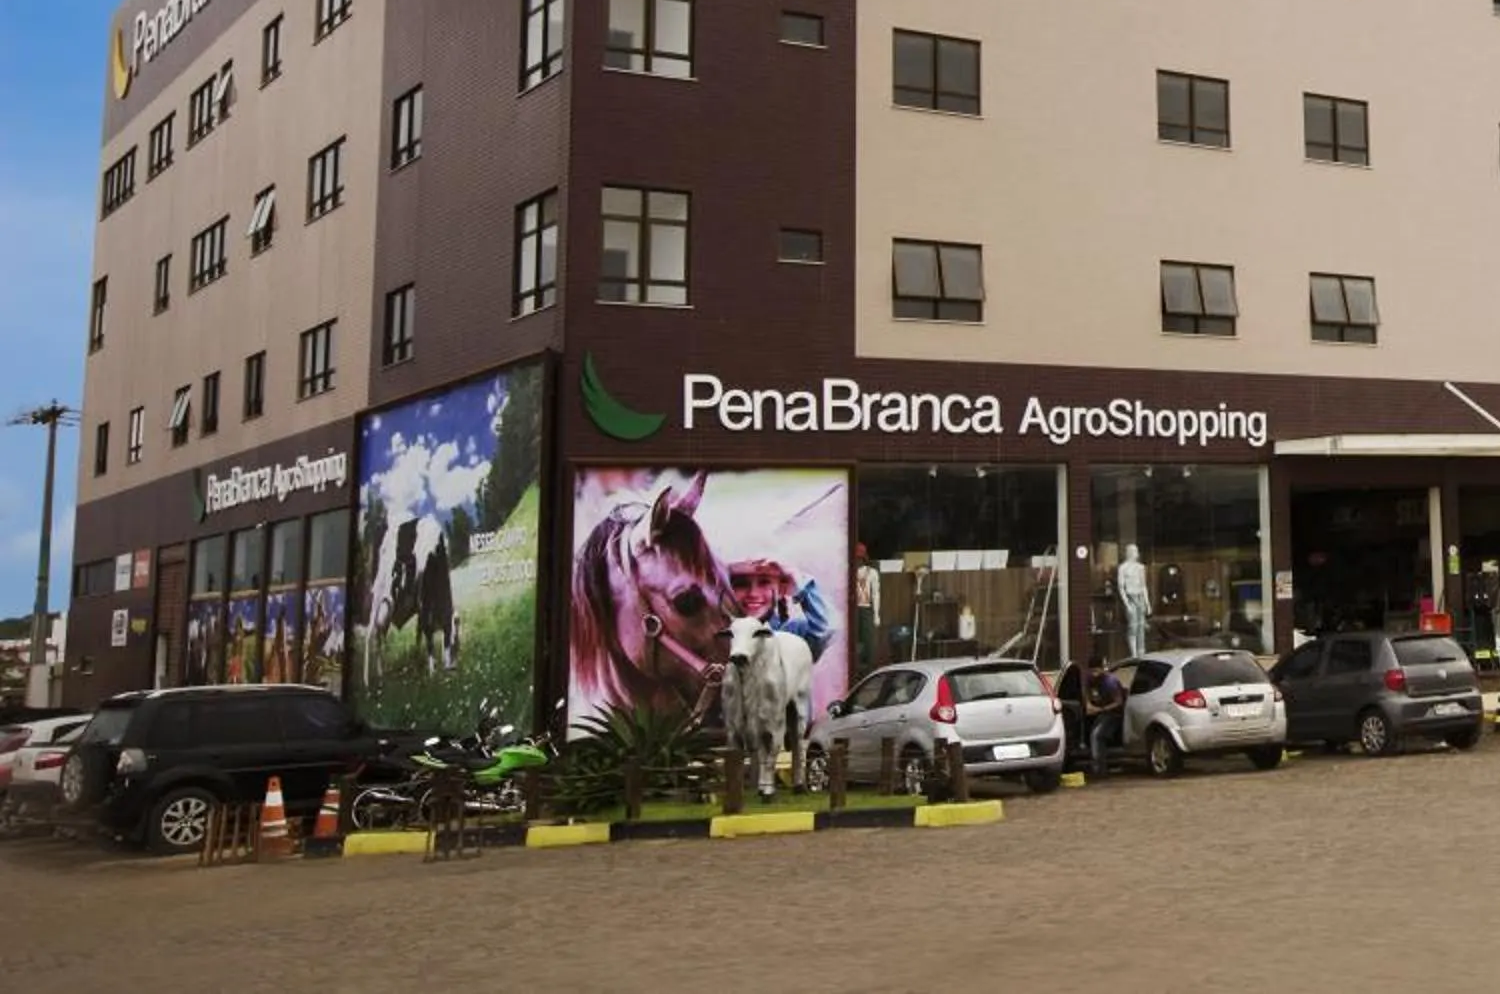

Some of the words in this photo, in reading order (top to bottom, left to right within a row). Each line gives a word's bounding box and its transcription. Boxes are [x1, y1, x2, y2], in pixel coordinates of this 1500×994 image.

[683, 373, 1004, 435] PenaBranca
[1018, 396, 1268, 448] AgroShopping
[205, 466, 272, 514] PenaBranca
[272, 447, 347, 503] AgroShopping
